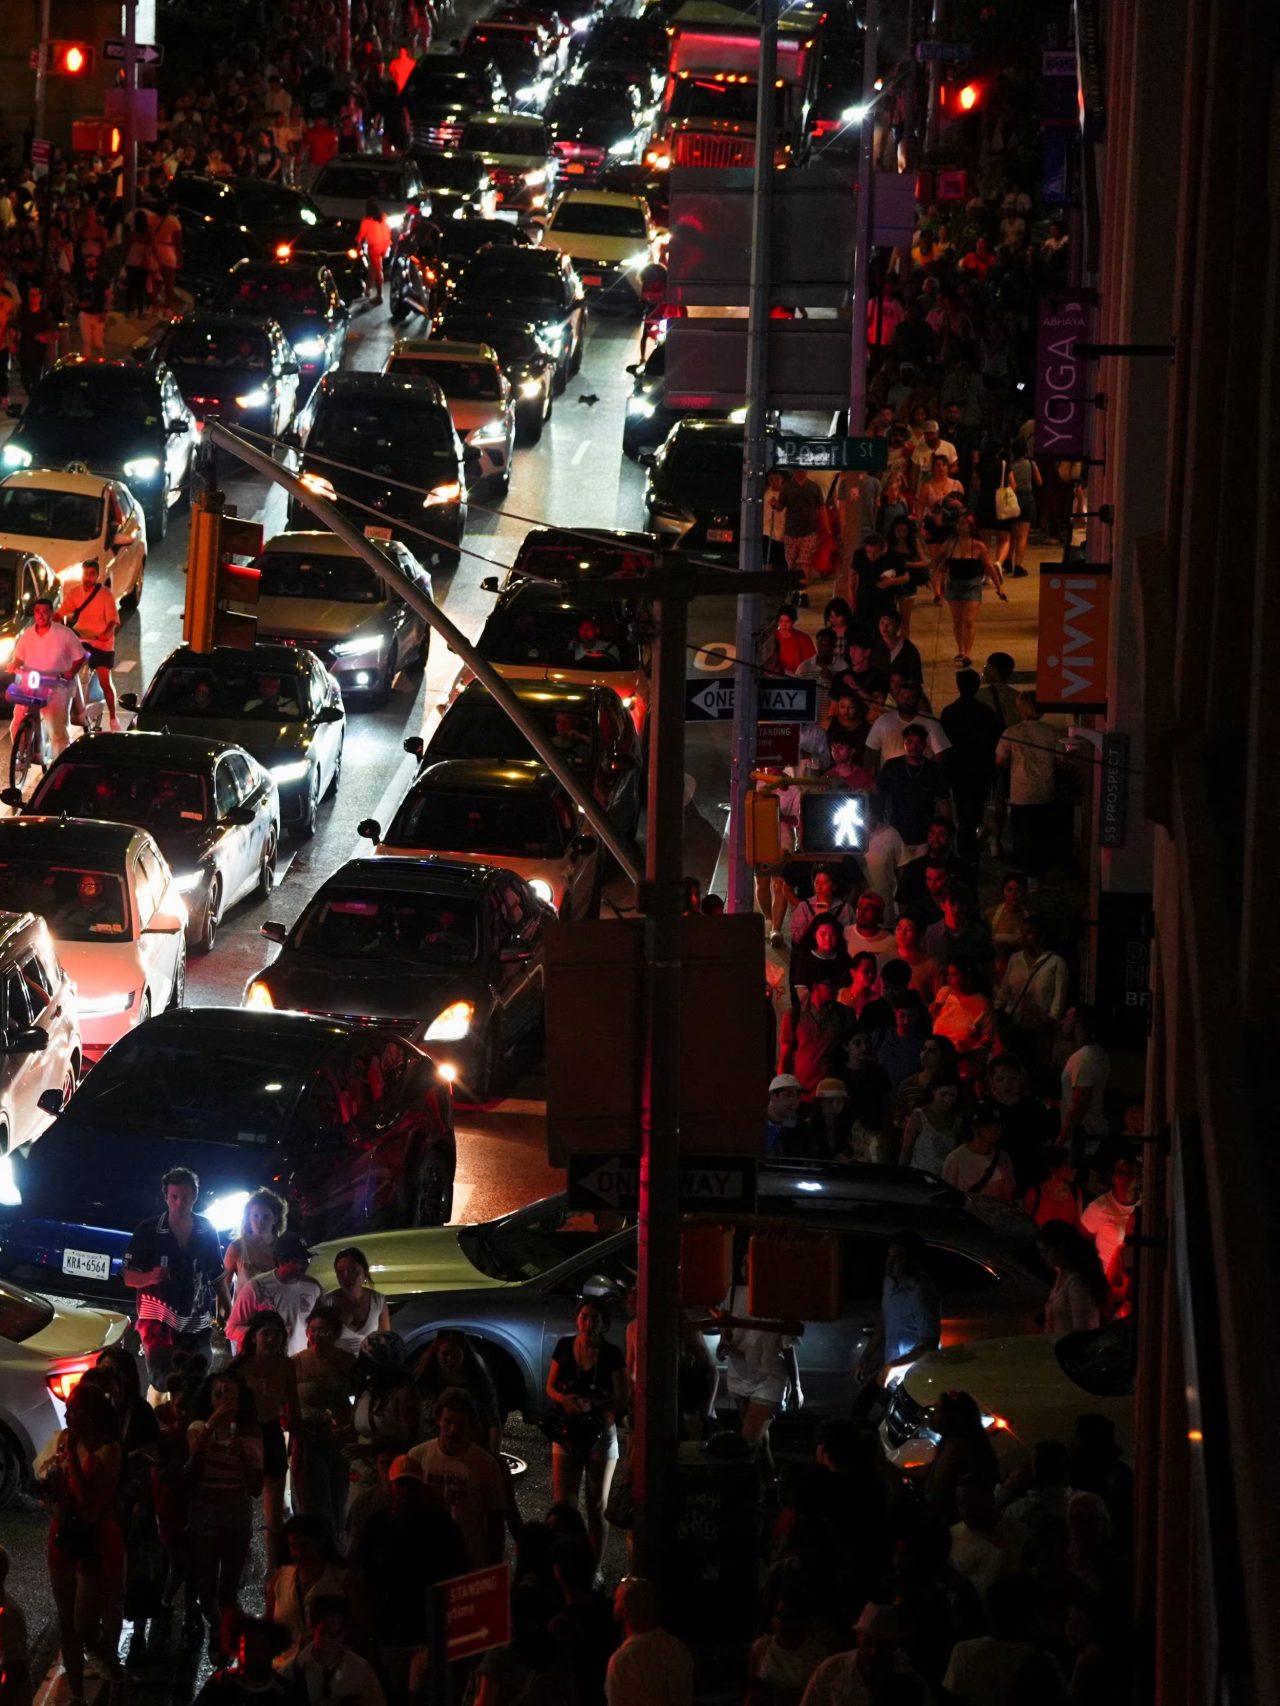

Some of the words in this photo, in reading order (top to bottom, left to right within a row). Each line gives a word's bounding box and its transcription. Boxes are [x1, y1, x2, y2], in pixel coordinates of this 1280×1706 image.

[1043, 317, 1086, 327] ABHAYA
[1043, 336, 1078, 448] YOGA
[785, 441, 848, 466] Pearl
[860, 442, 873, 458] St
[1046, 578, 1098, 700] vivvi
[704, 691, 736, 708] ONE
[760, 690, 799, 708] WAY
[759, 728, 792, 737] TANDING
[1106, 748, 1119, 822] PROSPECT
[598, 1171, 639, 1194] ON
[679, 1172, 730, 1195] WAY
